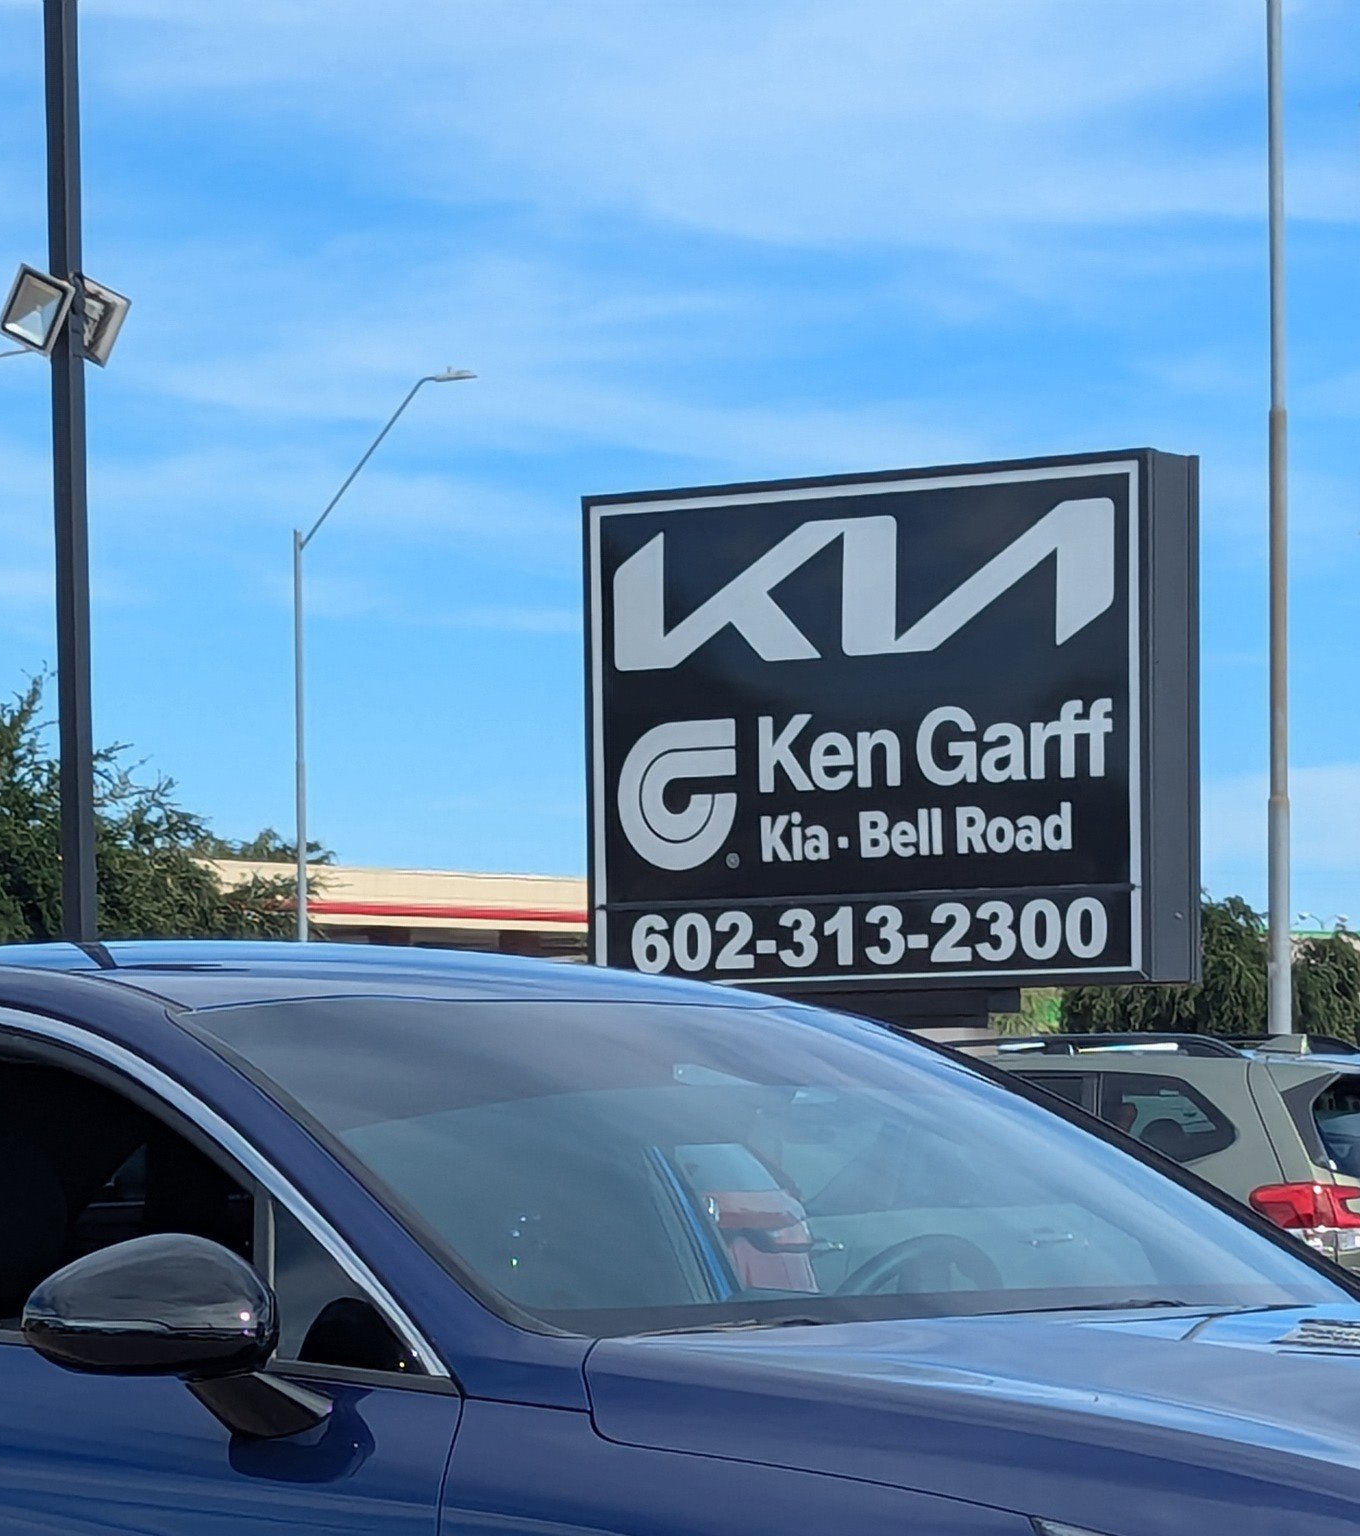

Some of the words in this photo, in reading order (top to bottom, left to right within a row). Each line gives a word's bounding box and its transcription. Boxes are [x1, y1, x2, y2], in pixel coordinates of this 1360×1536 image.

[613, 497, 1115, 671] KIA
[757, 713, 901, 794] Ken
[916, 698, 1114, 787] Garff
[760, 812, 830, 863] Kia
[858, 807, 943, 859] Bell
[956, 802, 1073, 856] Road
[631, 897, 1108, 974] 602-313-2300
